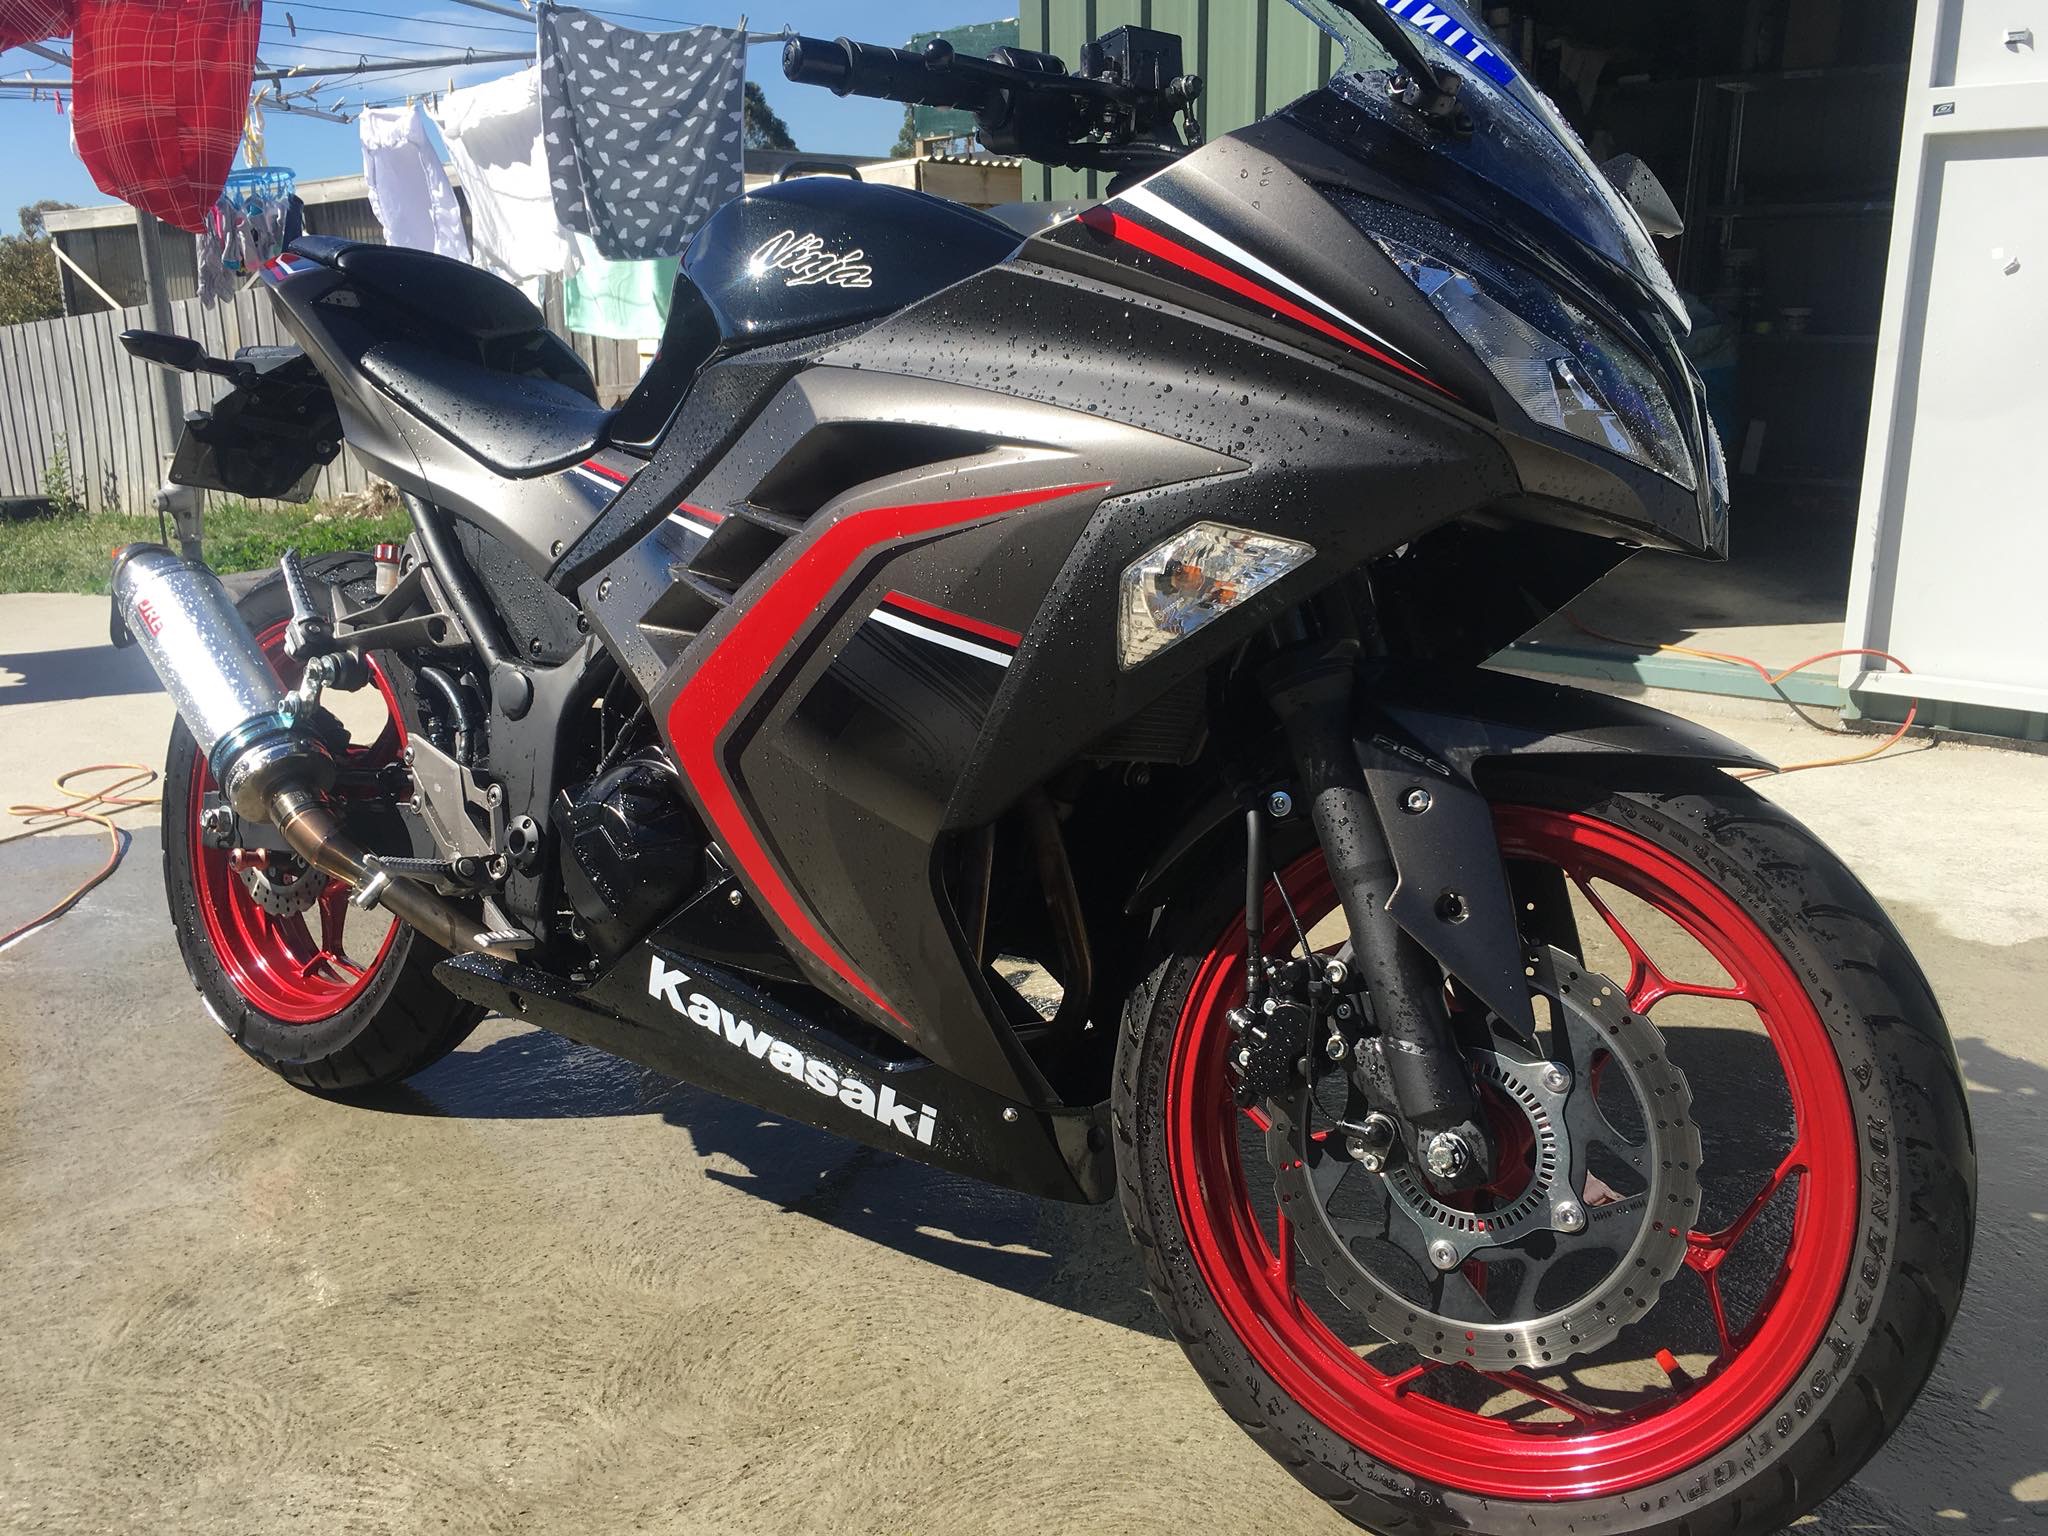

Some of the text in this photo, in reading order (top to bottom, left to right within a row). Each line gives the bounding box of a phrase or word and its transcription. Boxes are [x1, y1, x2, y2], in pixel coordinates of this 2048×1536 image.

[750, 230, 872, 287] Ninja
[1373, 734, 1450, 776] ABS
[648, 955, 938, 1146] Kawasaki
[1853, 1114, 1891, 1324] DUNLOP
